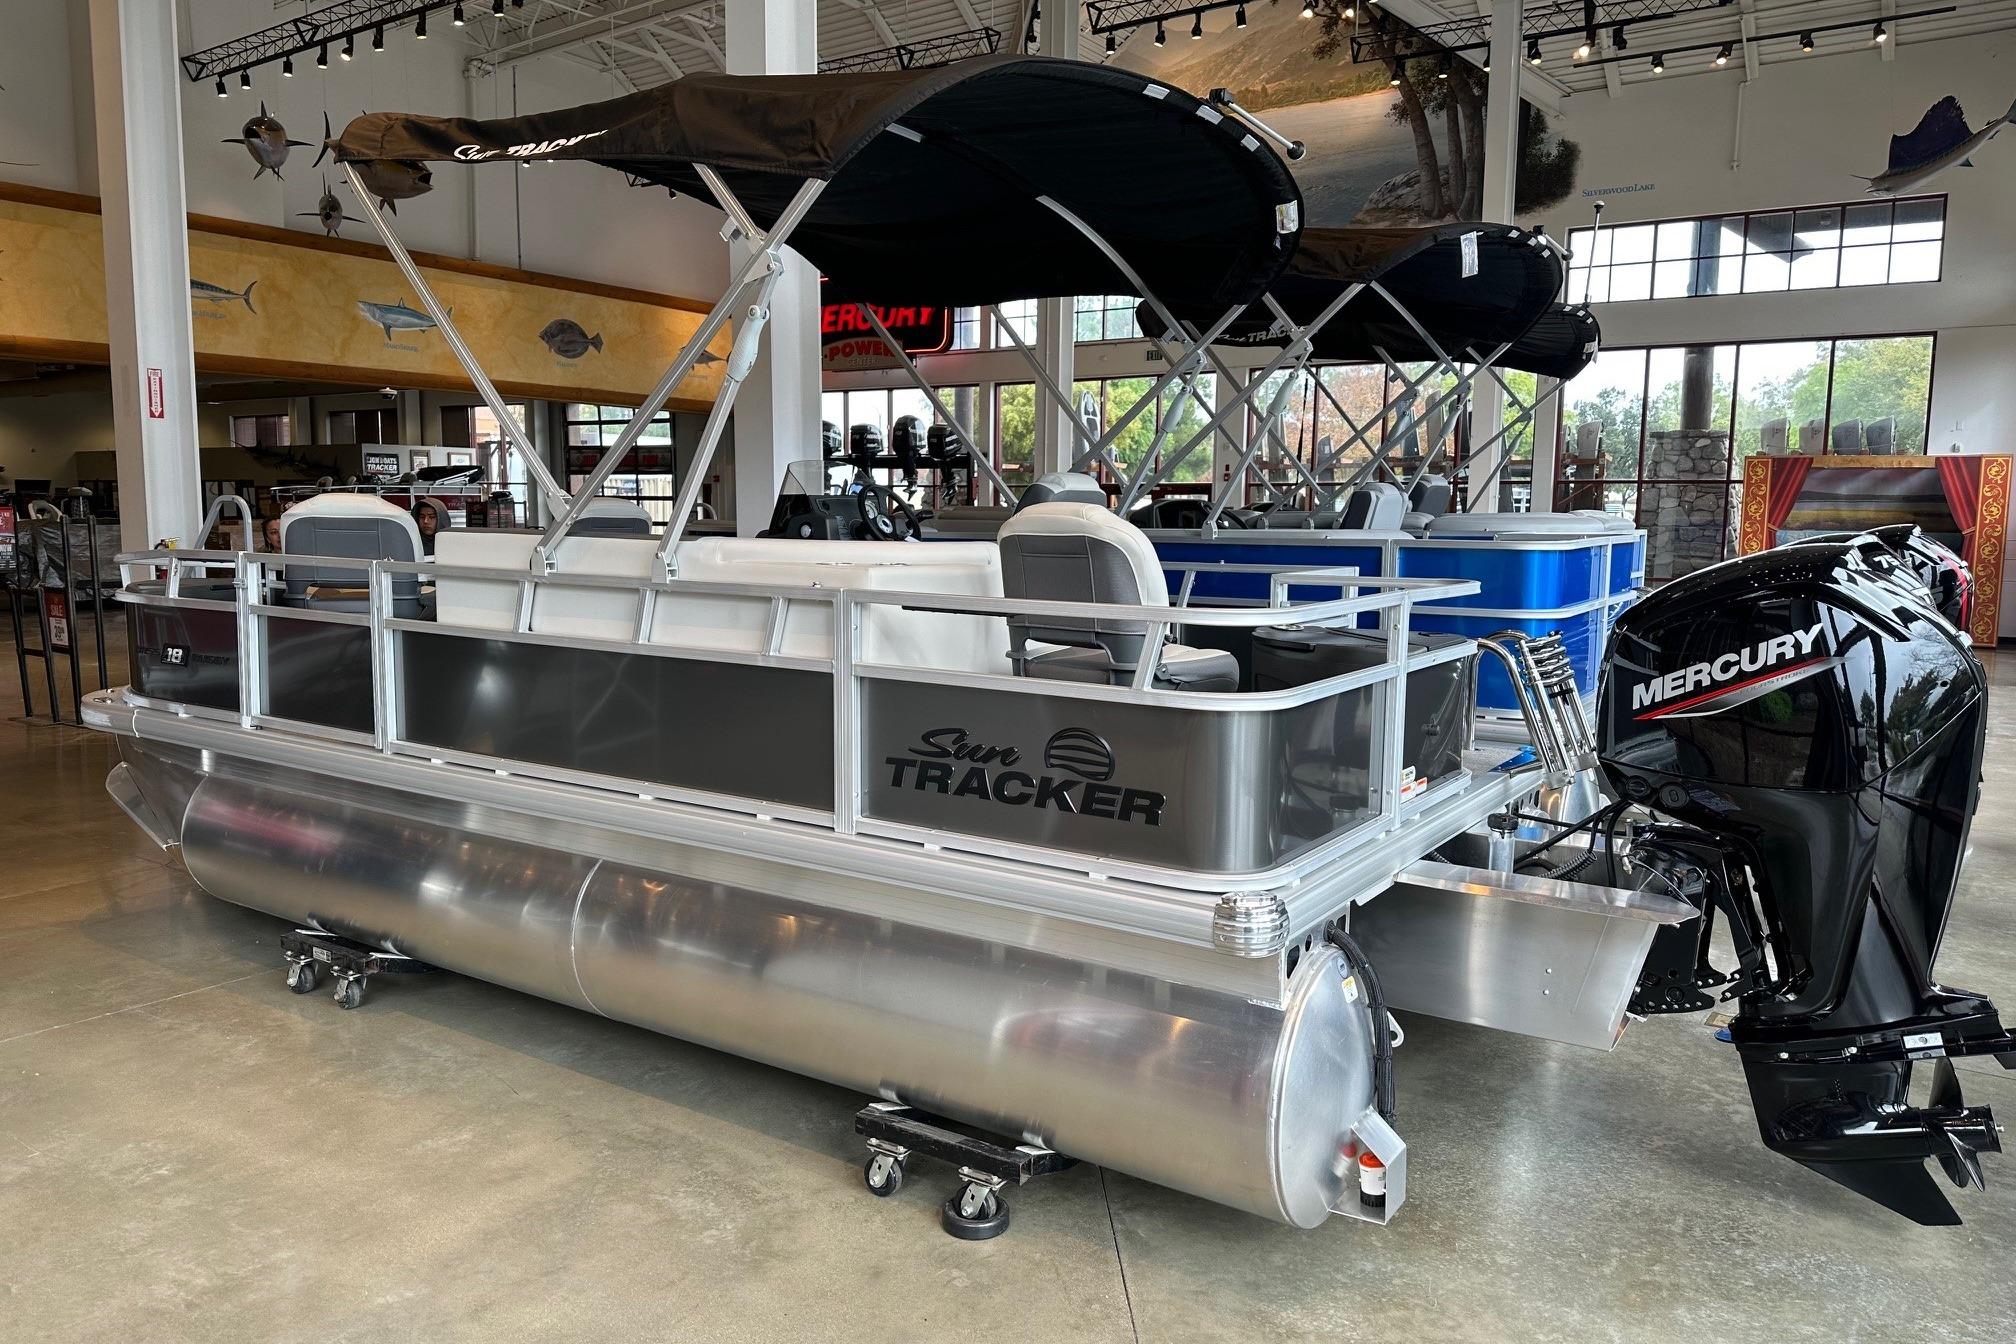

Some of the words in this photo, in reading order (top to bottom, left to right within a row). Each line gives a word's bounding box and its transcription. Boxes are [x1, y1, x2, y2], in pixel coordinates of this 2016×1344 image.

[1633, 184, 1655, 192] LAKE
[820, 302, 936, 333] ERCURY
[166, 647, 183, 663] 18
[1633, 623, 1823, 710] MERCURY
[908, 728, 1022, 766] Sun
[885, 757, 1167, 827] TRACKER
